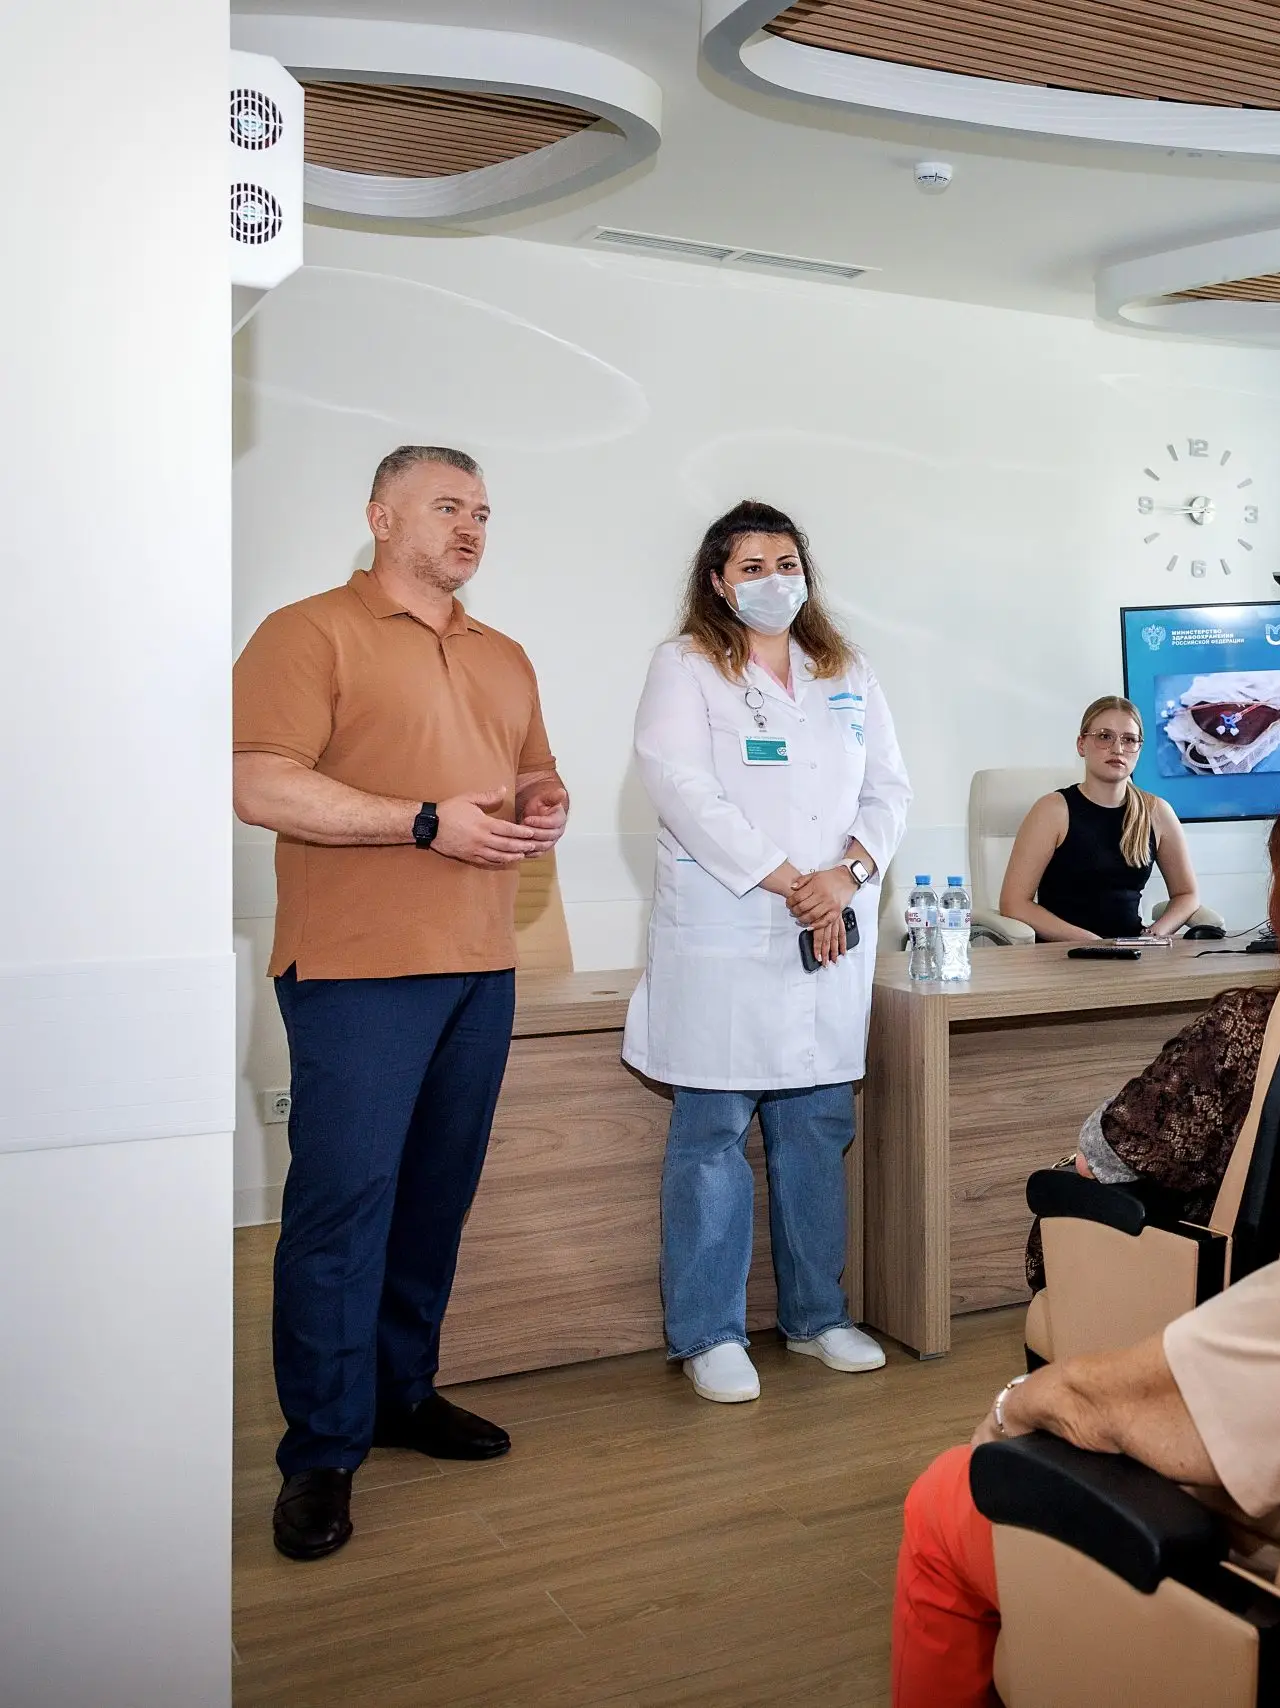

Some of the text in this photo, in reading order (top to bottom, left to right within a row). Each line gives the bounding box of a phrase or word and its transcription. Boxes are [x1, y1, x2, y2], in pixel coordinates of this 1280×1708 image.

[1187, 438, 1209, 457] 12
[1138, 496, 1154, 515] 9
[1244, 505, 1259, 523] 3
[1191, 560, 1207, 578] 6
[1171, 633, 1234, 641] ЗДРАВООХРАНЕНИЯ
